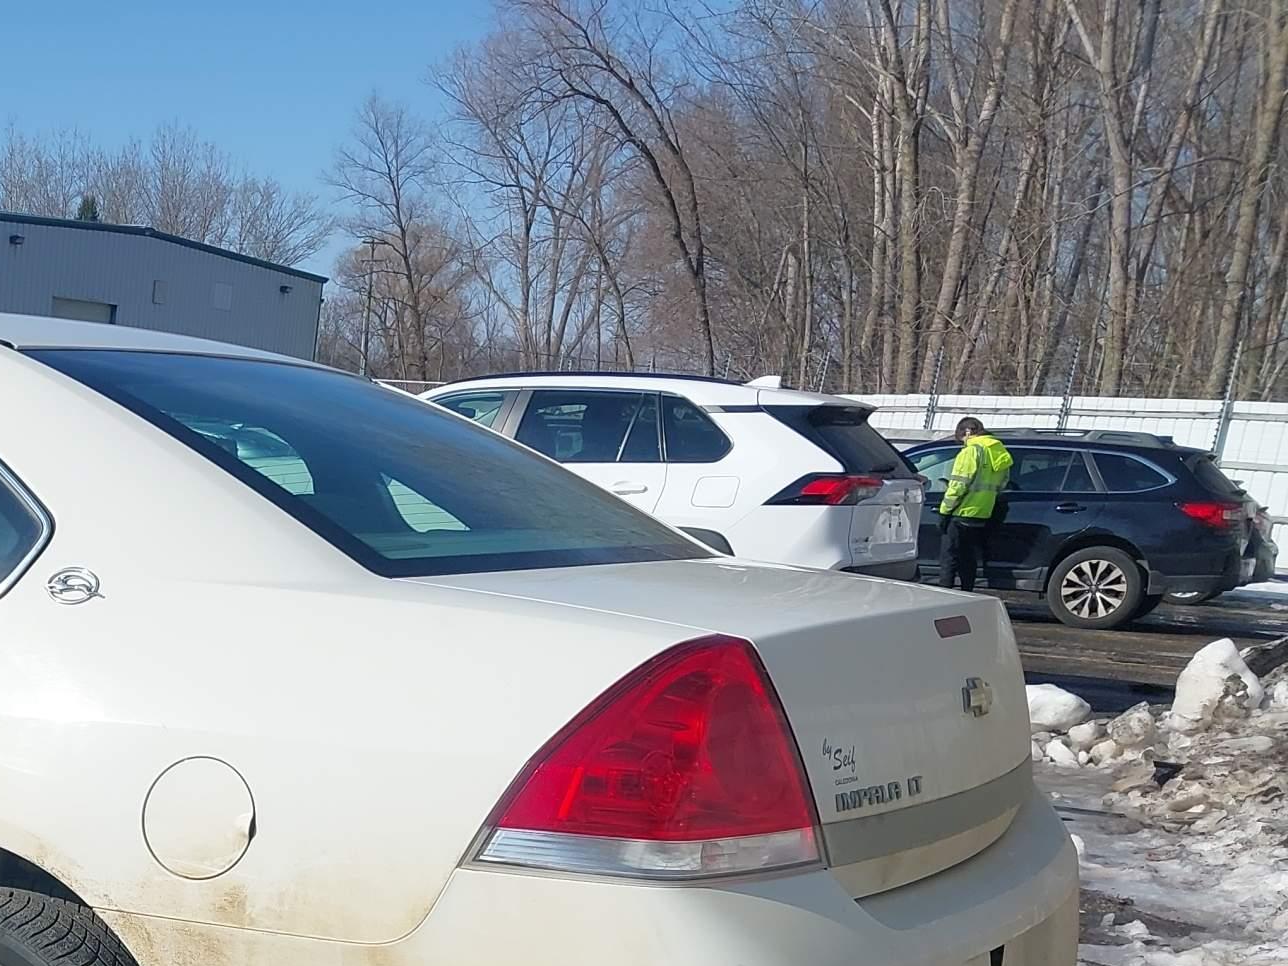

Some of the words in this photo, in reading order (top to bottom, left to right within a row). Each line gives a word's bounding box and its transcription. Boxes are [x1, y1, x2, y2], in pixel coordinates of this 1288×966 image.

[822, 737, 832, 760] by
[833, 745, 856, 773] Seif
[835, 781, 902, 812] IMPALA
[907, 775, 923, 797] LT
